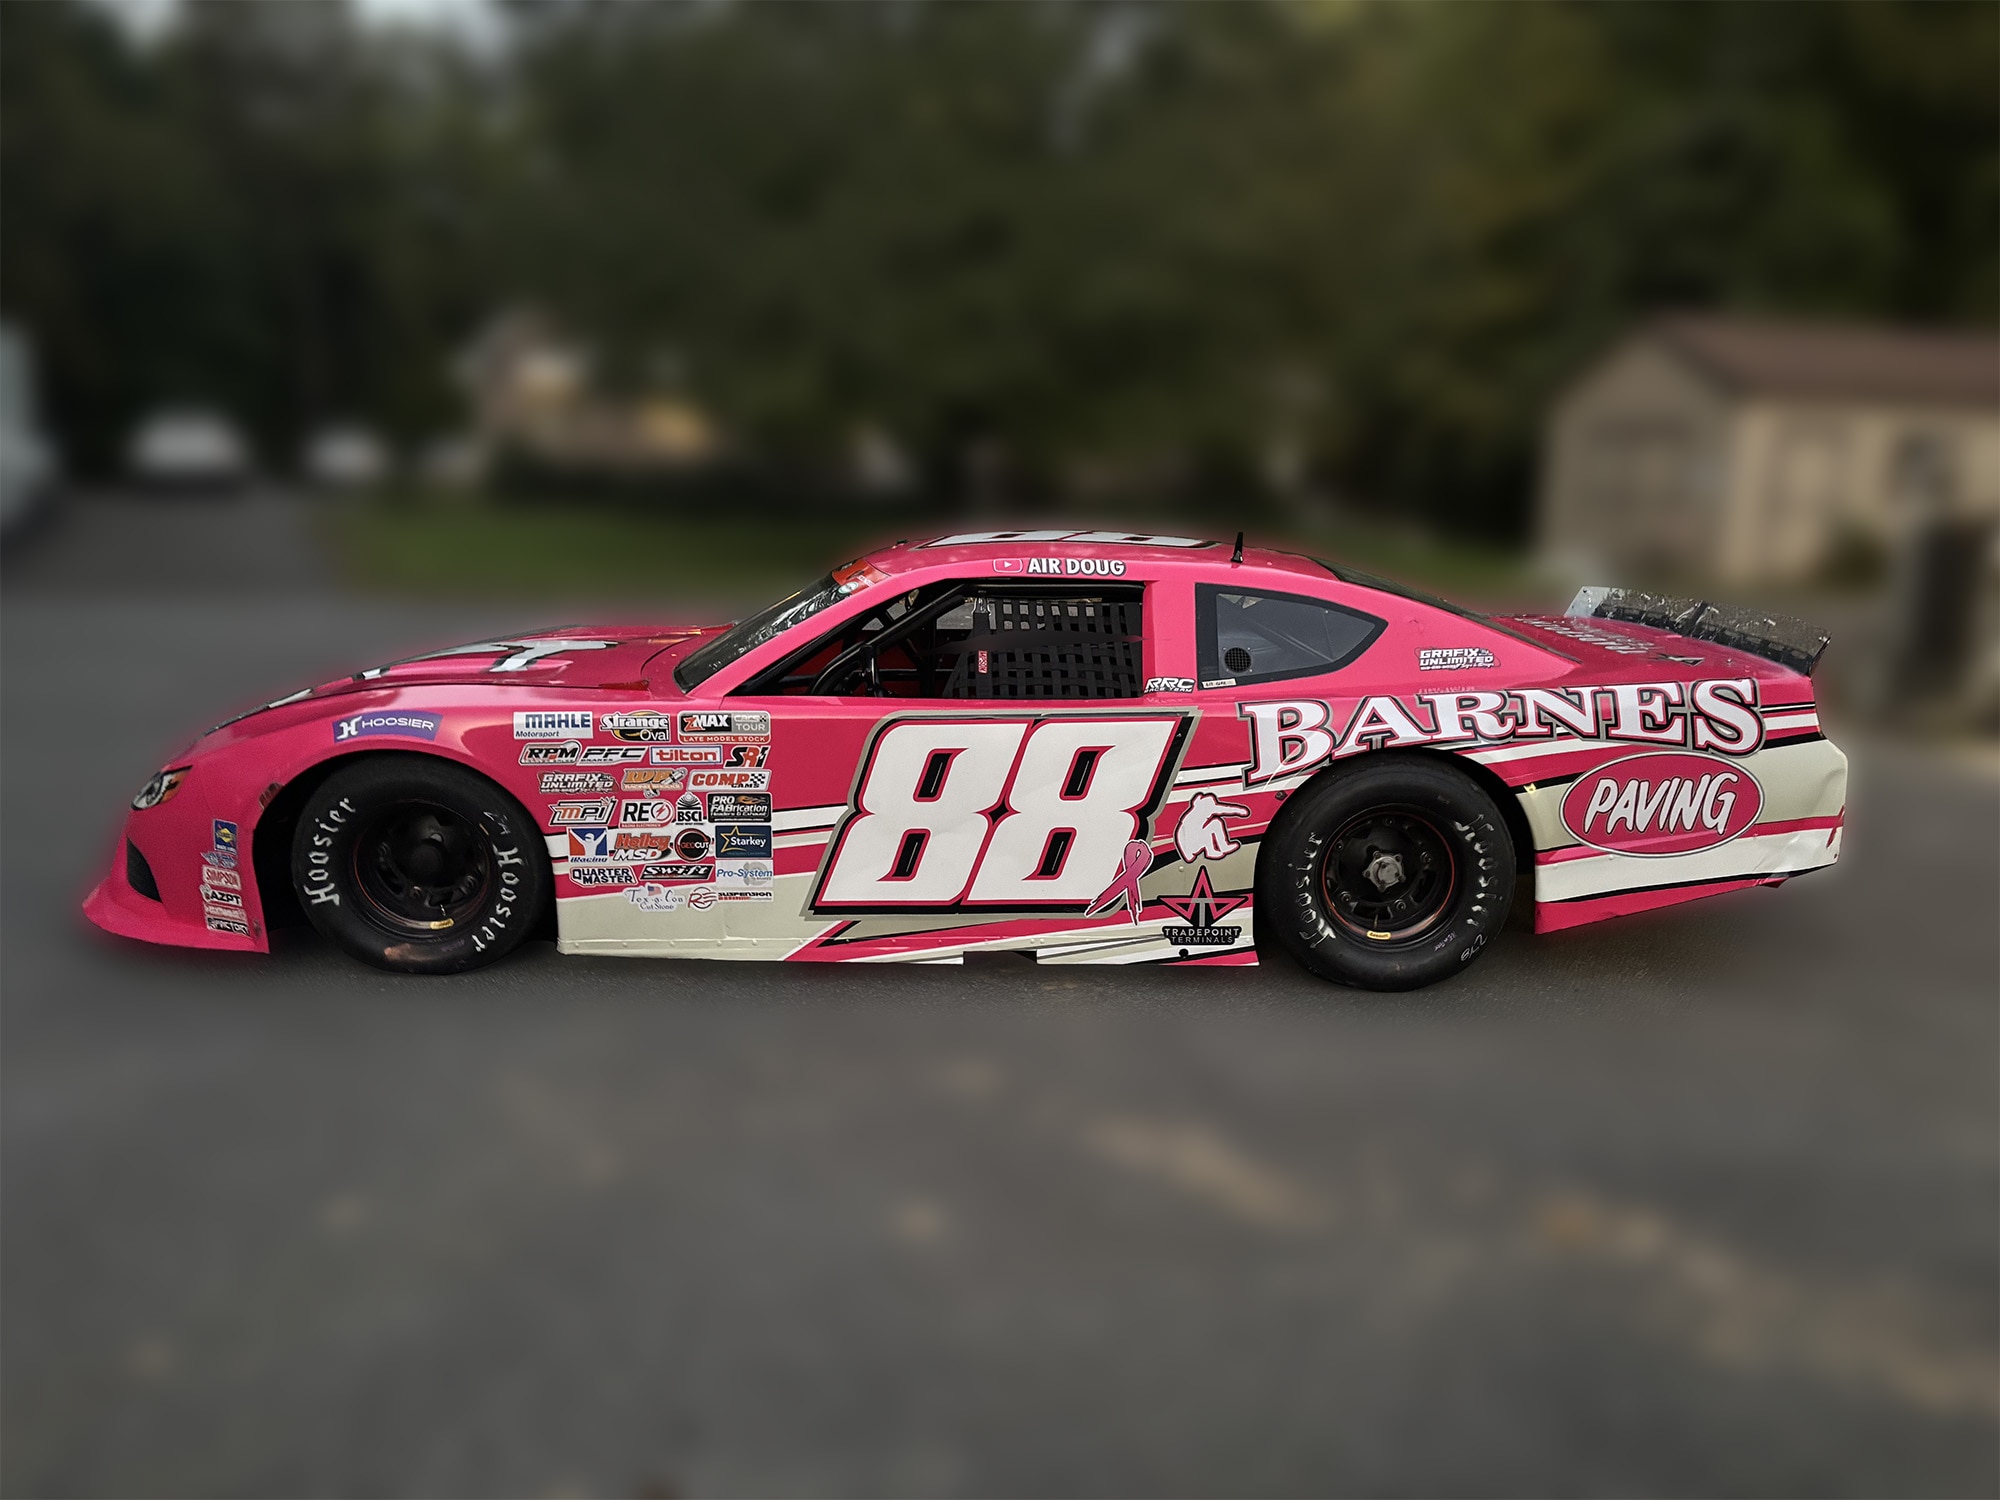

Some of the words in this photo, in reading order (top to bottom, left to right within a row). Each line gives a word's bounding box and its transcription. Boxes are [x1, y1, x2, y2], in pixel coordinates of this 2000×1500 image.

[1027, 558, 1062, 574] AIR
[1066, 558, 1125, 575] DOUG
[1419, 648, 1480, 659] GRAFIX
[1419, 655, 1494, 666] UNLIMITED
[1145, 677, 1196, 690] RRC
[361, 717, 434, 731] HOOSIER
[525, 713, 591, 729] MAHLE
[602, 713, 669, 729] Strange
[736, 723, 766, 731] TOUR
[515, 730, 560, 738] Motorsport
[640, 729, 670, 741] Oval
[1242, 677, 1761, 784] BARNES
[583, 747, 646, 758] PFC
[656, 749, 718, 761] tilton
[692, 773, 750, 786] COMP
[712, 795, 735, 805] PRO
[1583, 770, 1740, 835] PAVING
[810, 712, 1190, 911] 88
[730, 836, 767, 848] Starkey
[303, 797, 357, 907] Hoosier
[613, 848, 662, 861] MSD
[572, 868, 630, 880] QUARTER
[583, 875, 634, 885] MASTER
[716, 869, 773, 879] Pro-System
[471, 844, 526, 953] Hoosier
[1164, 928, 1240, 936] TRADEPOINT
